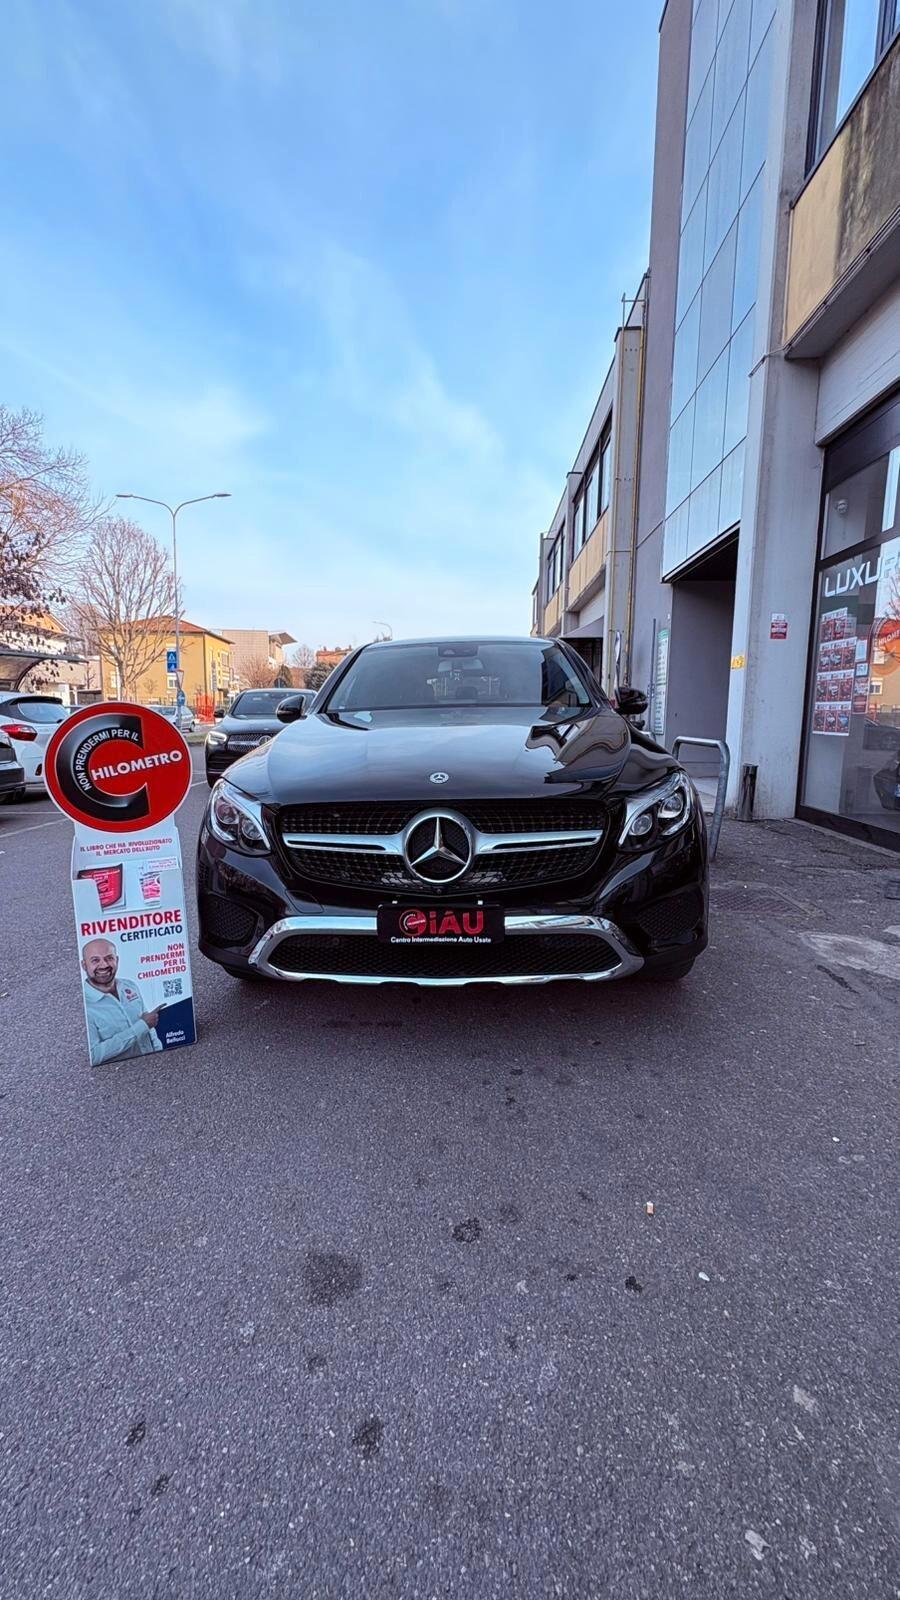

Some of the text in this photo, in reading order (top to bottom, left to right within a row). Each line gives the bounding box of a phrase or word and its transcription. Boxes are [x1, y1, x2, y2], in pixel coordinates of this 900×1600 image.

[76, 729, 139, 791] NON PRENDERMI PER IL
[128, 839, 172, 847] RIVOLUZIONATO
[104, 848, 130, 856] MERCATO
[81, 910, 182, 936] RIVENDITORE
[120, 925, 183, 942] CERTIFICATO
[140, 951, 185, 964] PRENDERMI
[138, 966, 186, 980] CHILOMETRO
[166, 1030, 184, 1038] Alfredo
